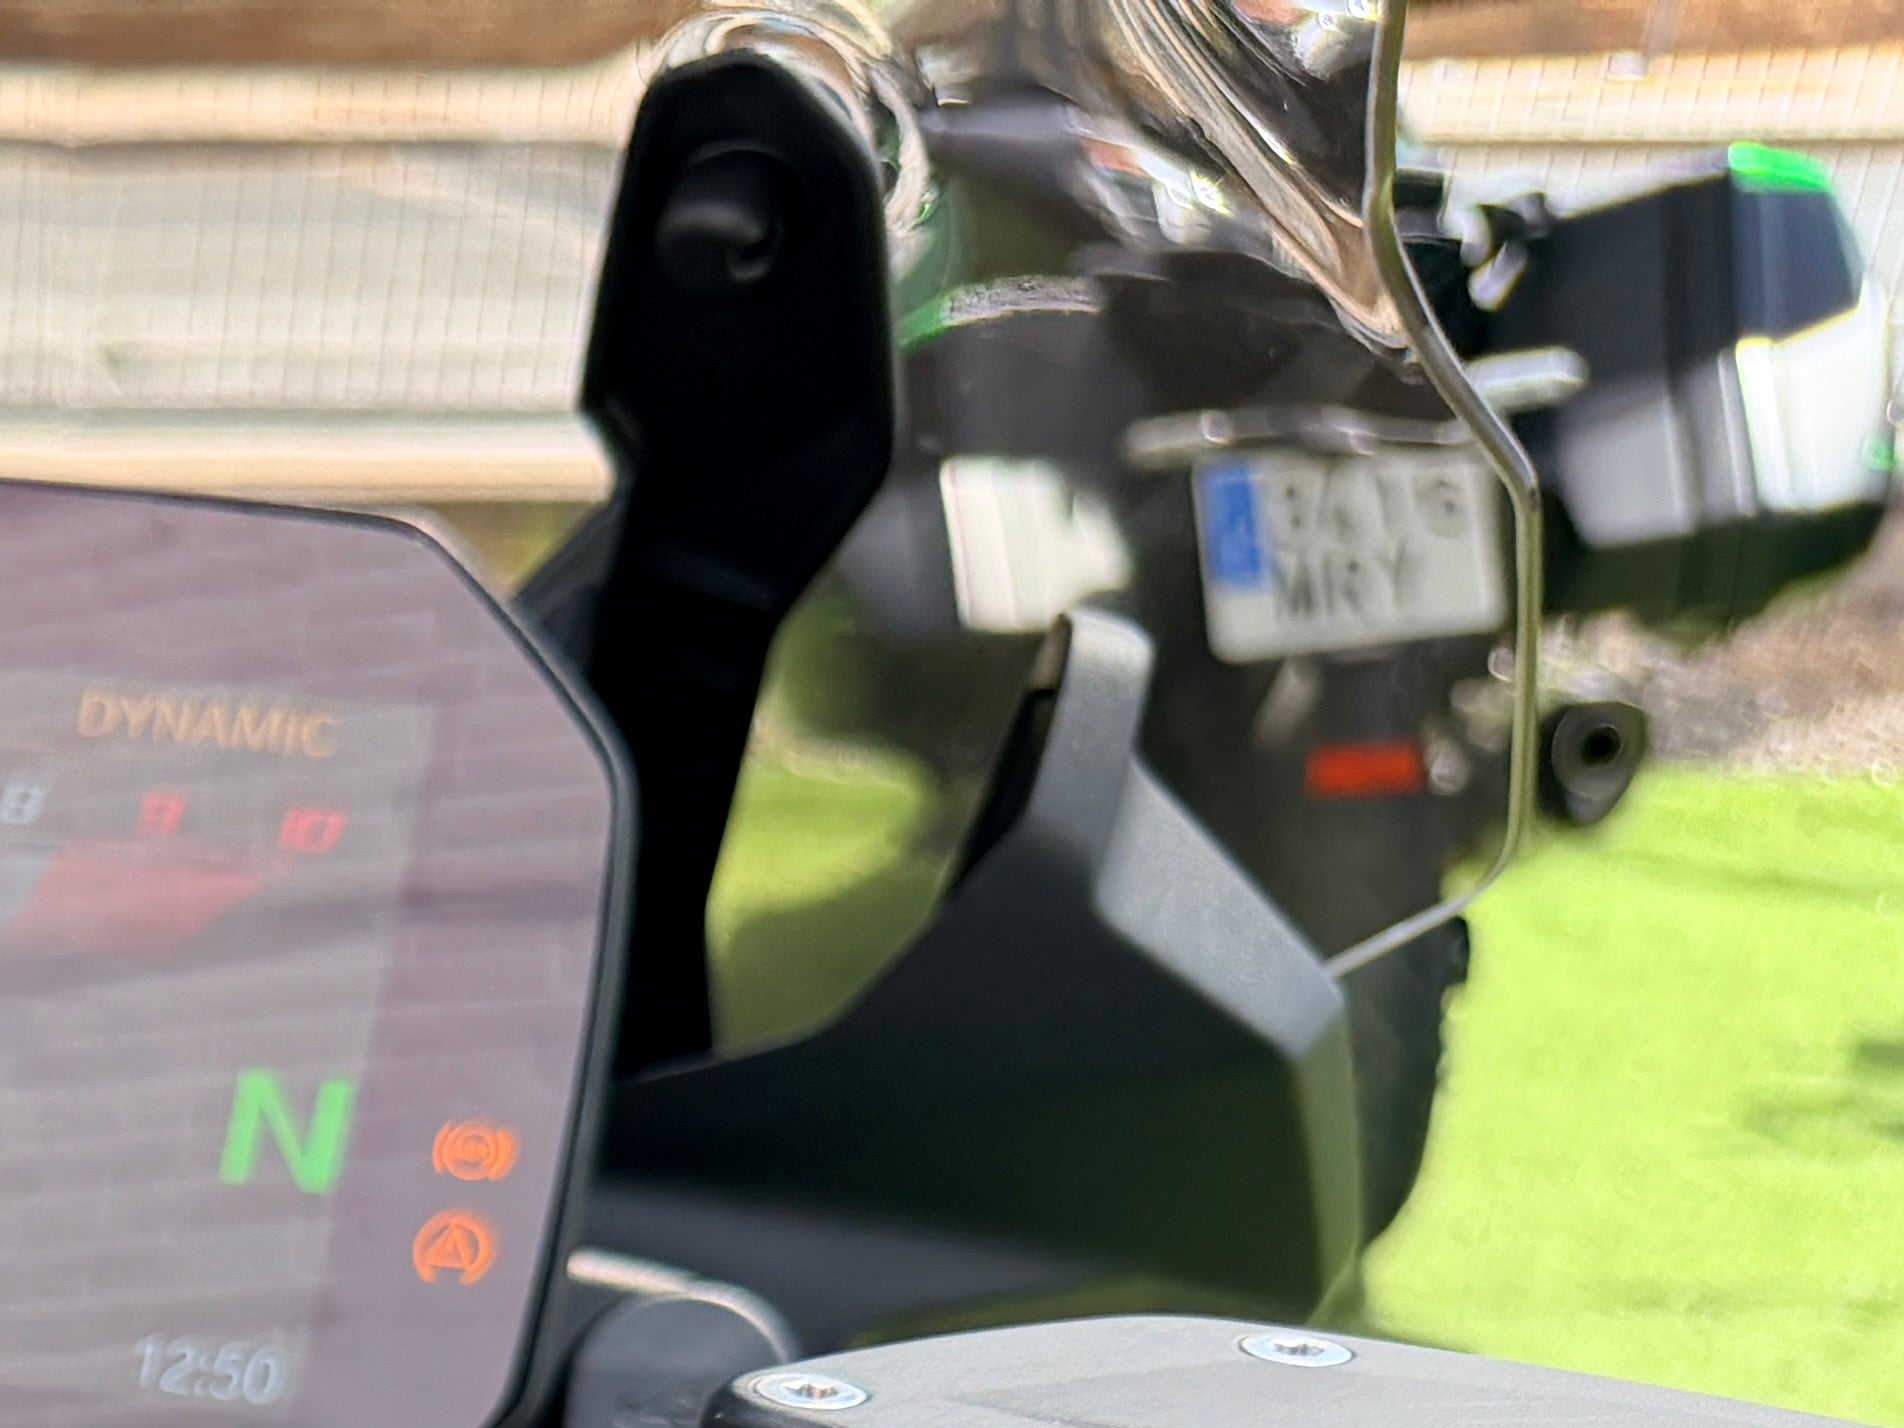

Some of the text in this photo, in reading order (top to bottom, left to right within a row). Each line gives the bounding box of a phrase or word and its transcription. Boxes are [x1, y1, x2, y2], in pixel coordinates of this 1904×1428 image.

[77, 688, 340, 759] DYNAMIC
[138, 792, 187, 838] 9
[280, 807, 348, 855] 10
[217, 1069, 351, 1194] N
[135, 1333, 284, 1405] 12:50
